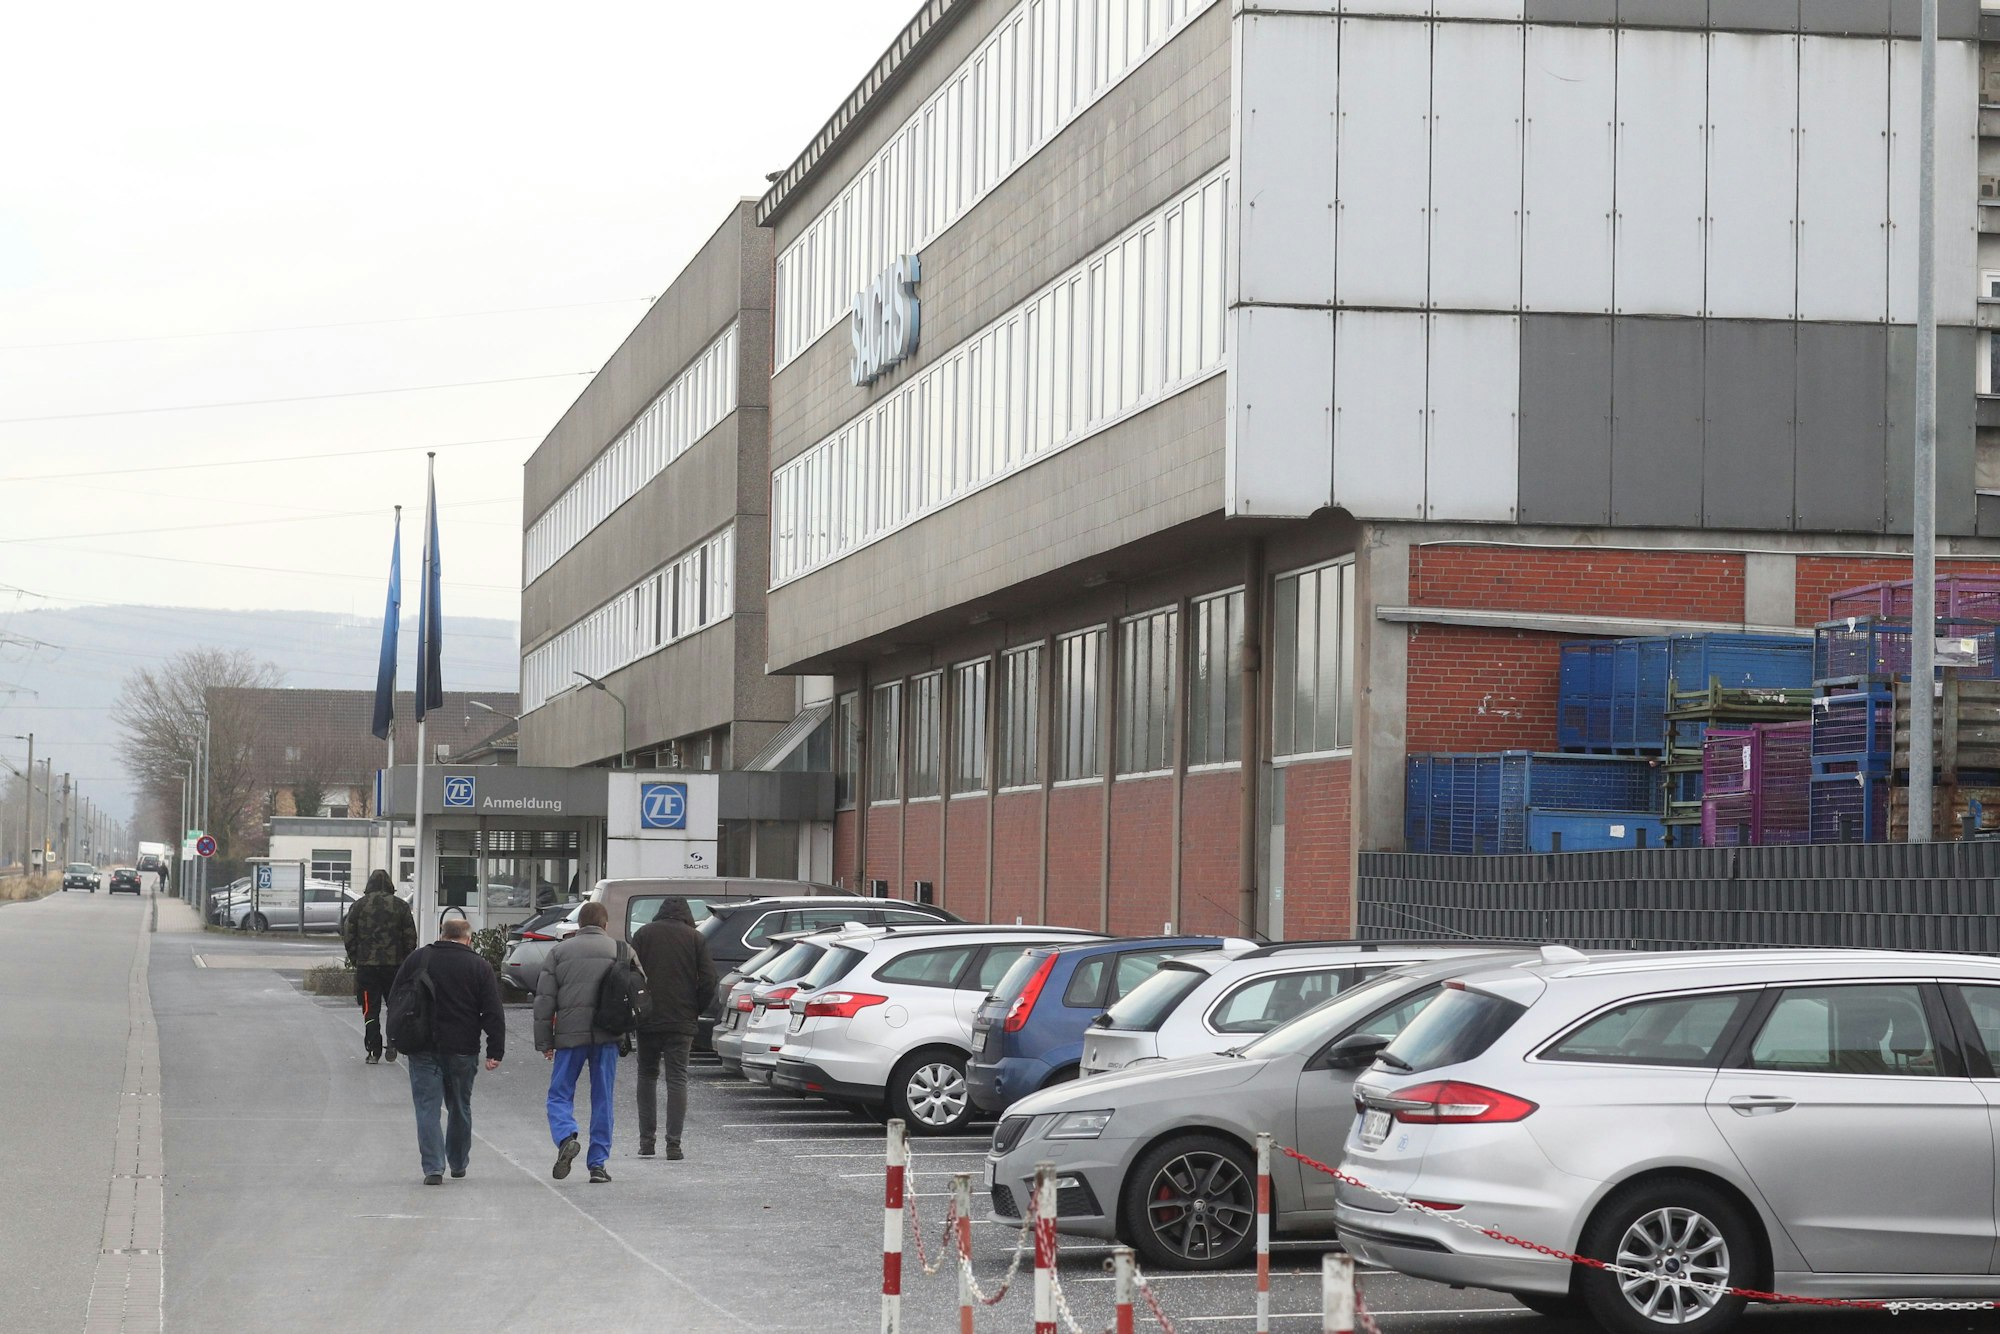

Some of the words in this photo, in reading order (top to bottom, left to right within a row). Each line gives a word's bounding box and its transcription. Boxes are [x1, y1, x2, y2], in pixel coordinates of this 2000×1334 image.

[851, 254, 916, 387] SACHS
[448, 783, 471, 800] ZF
[483, 797, 562, 812] Anmeldung
[645, 793, 683, 819] ZF
